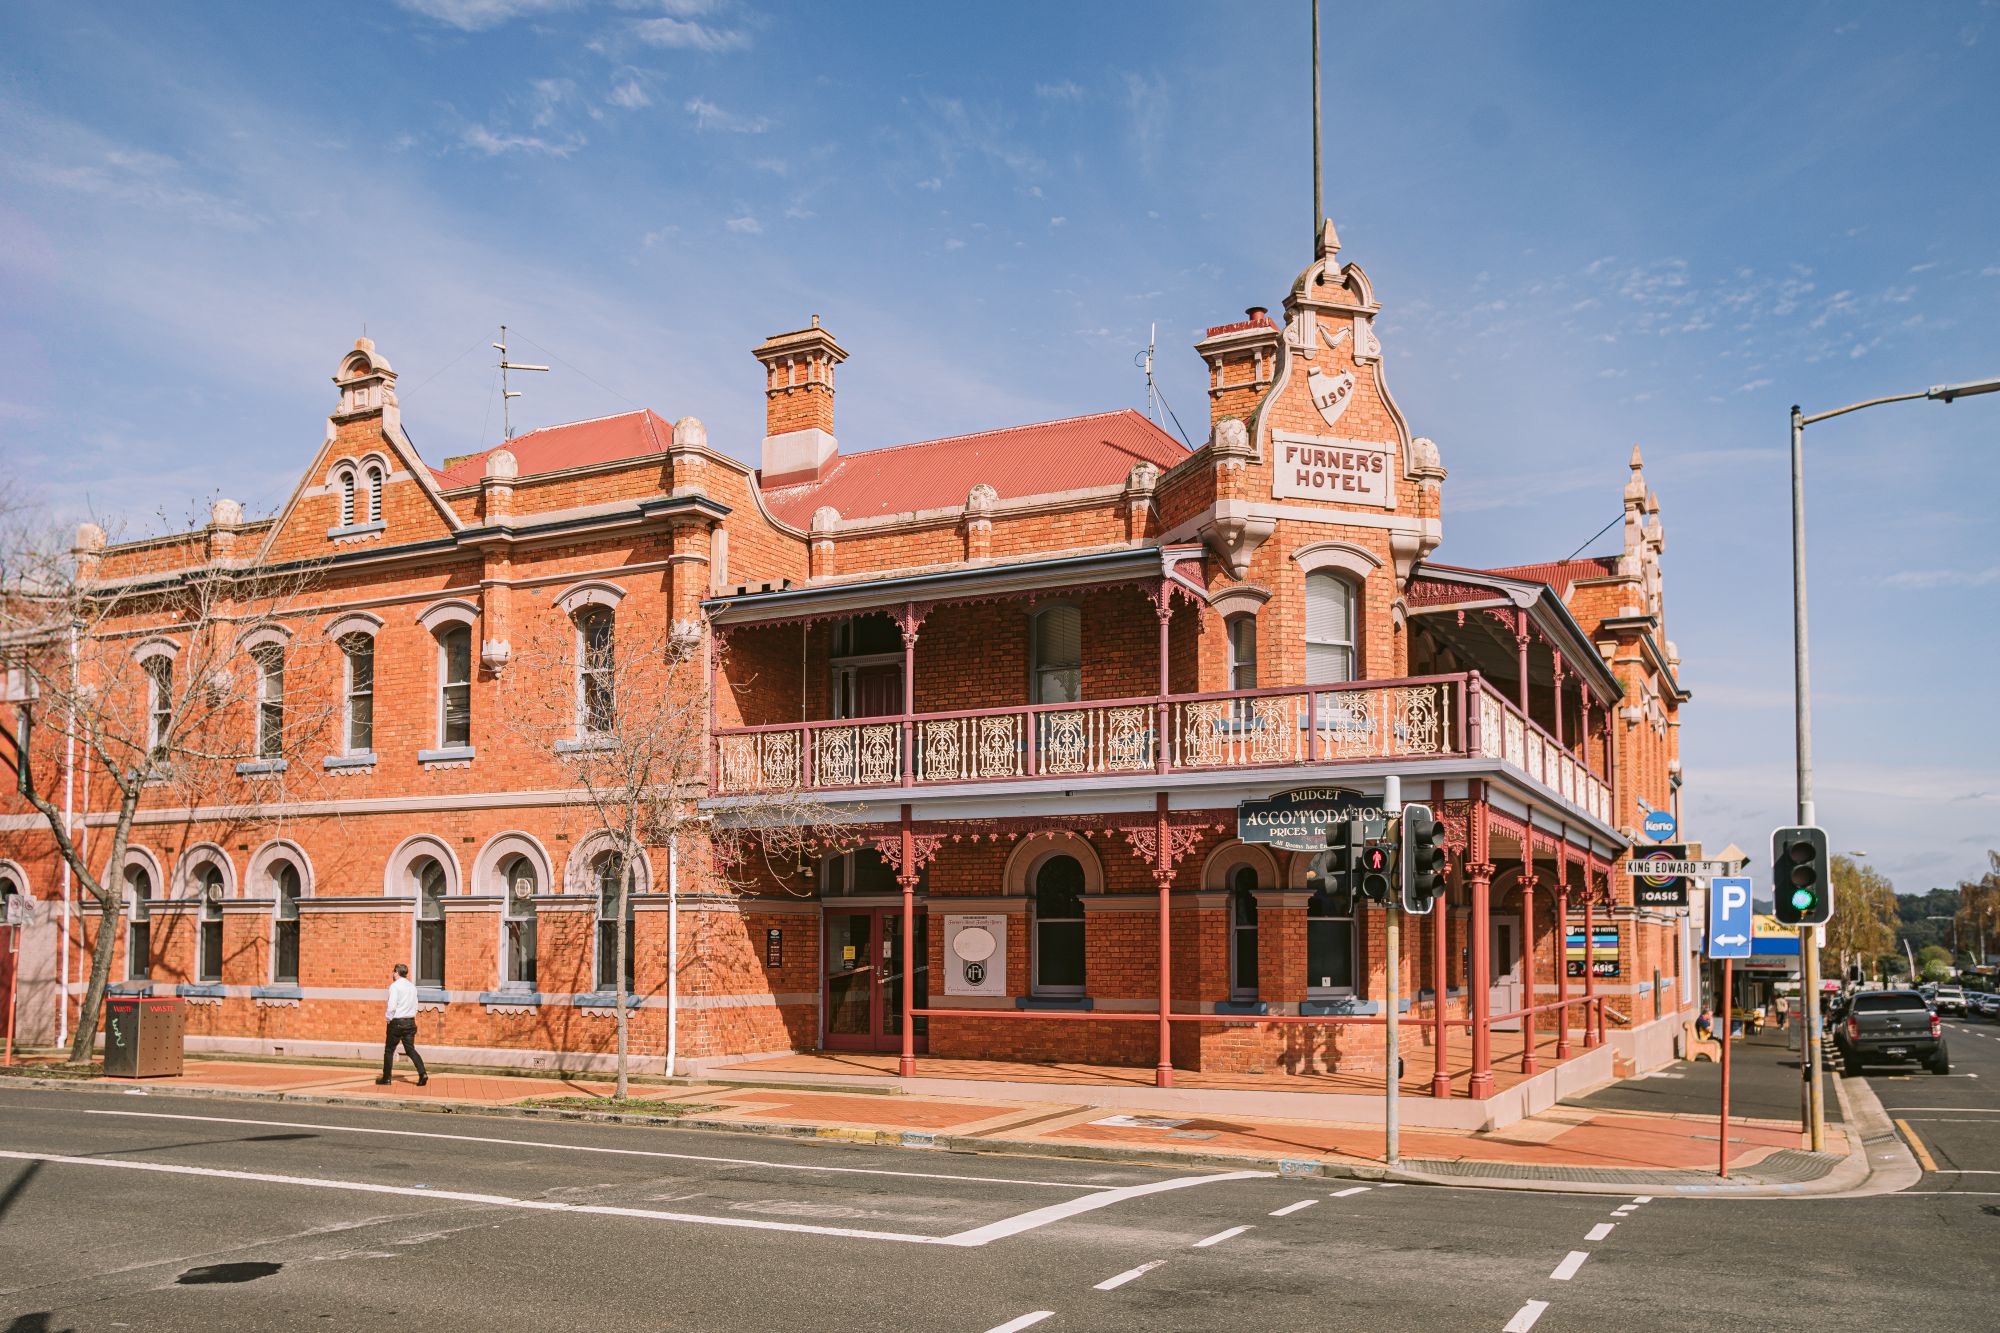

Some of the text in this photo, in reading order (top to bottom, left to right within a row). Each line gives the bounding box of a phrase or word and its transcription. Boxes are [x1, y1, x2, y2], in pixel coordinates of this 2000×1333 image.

[1321, 378, 1353, 407] 1903
[1285, 446, 1383, 474] FURNER'S
[1296, 469, 1371, 493] HOTEL
[1290, 789, 1341, 803] BUDGET
[1246, 807, 1387, 826] ACCOMMODAION
[1269, 827, 1308, 837] PRICES
[1627, 861, 1650, 873] KING
[1655, 862, 1696, 874] EDWARD
[1645, 891, 1679, 901] OASIS
[1721, 885, 1747, 921] P
[1591, 963, 1614, 973] ASIS
[150, 1005, 177, 1013] WASTE
